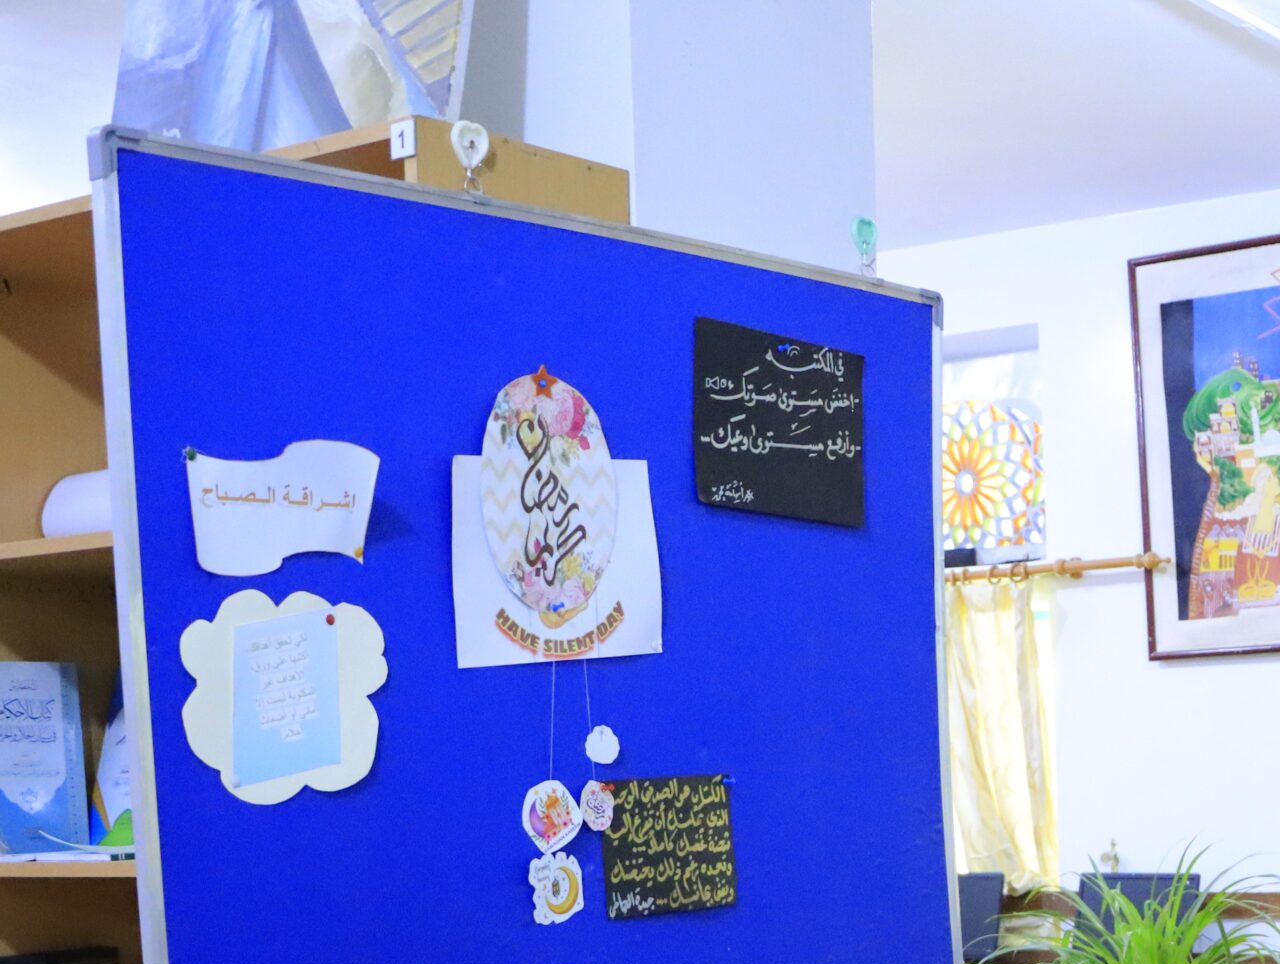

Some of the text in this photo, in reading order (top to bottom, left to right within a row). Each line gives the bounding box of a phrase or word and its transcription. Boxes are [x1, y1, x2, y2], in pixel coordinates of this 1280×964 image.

[398, 130, 405, 149] 1
[834, 351, 845, 382] في
[201, 484, 276, 509] الصباح
[495, 600, 625, 659] HAVE SILENT DAY
